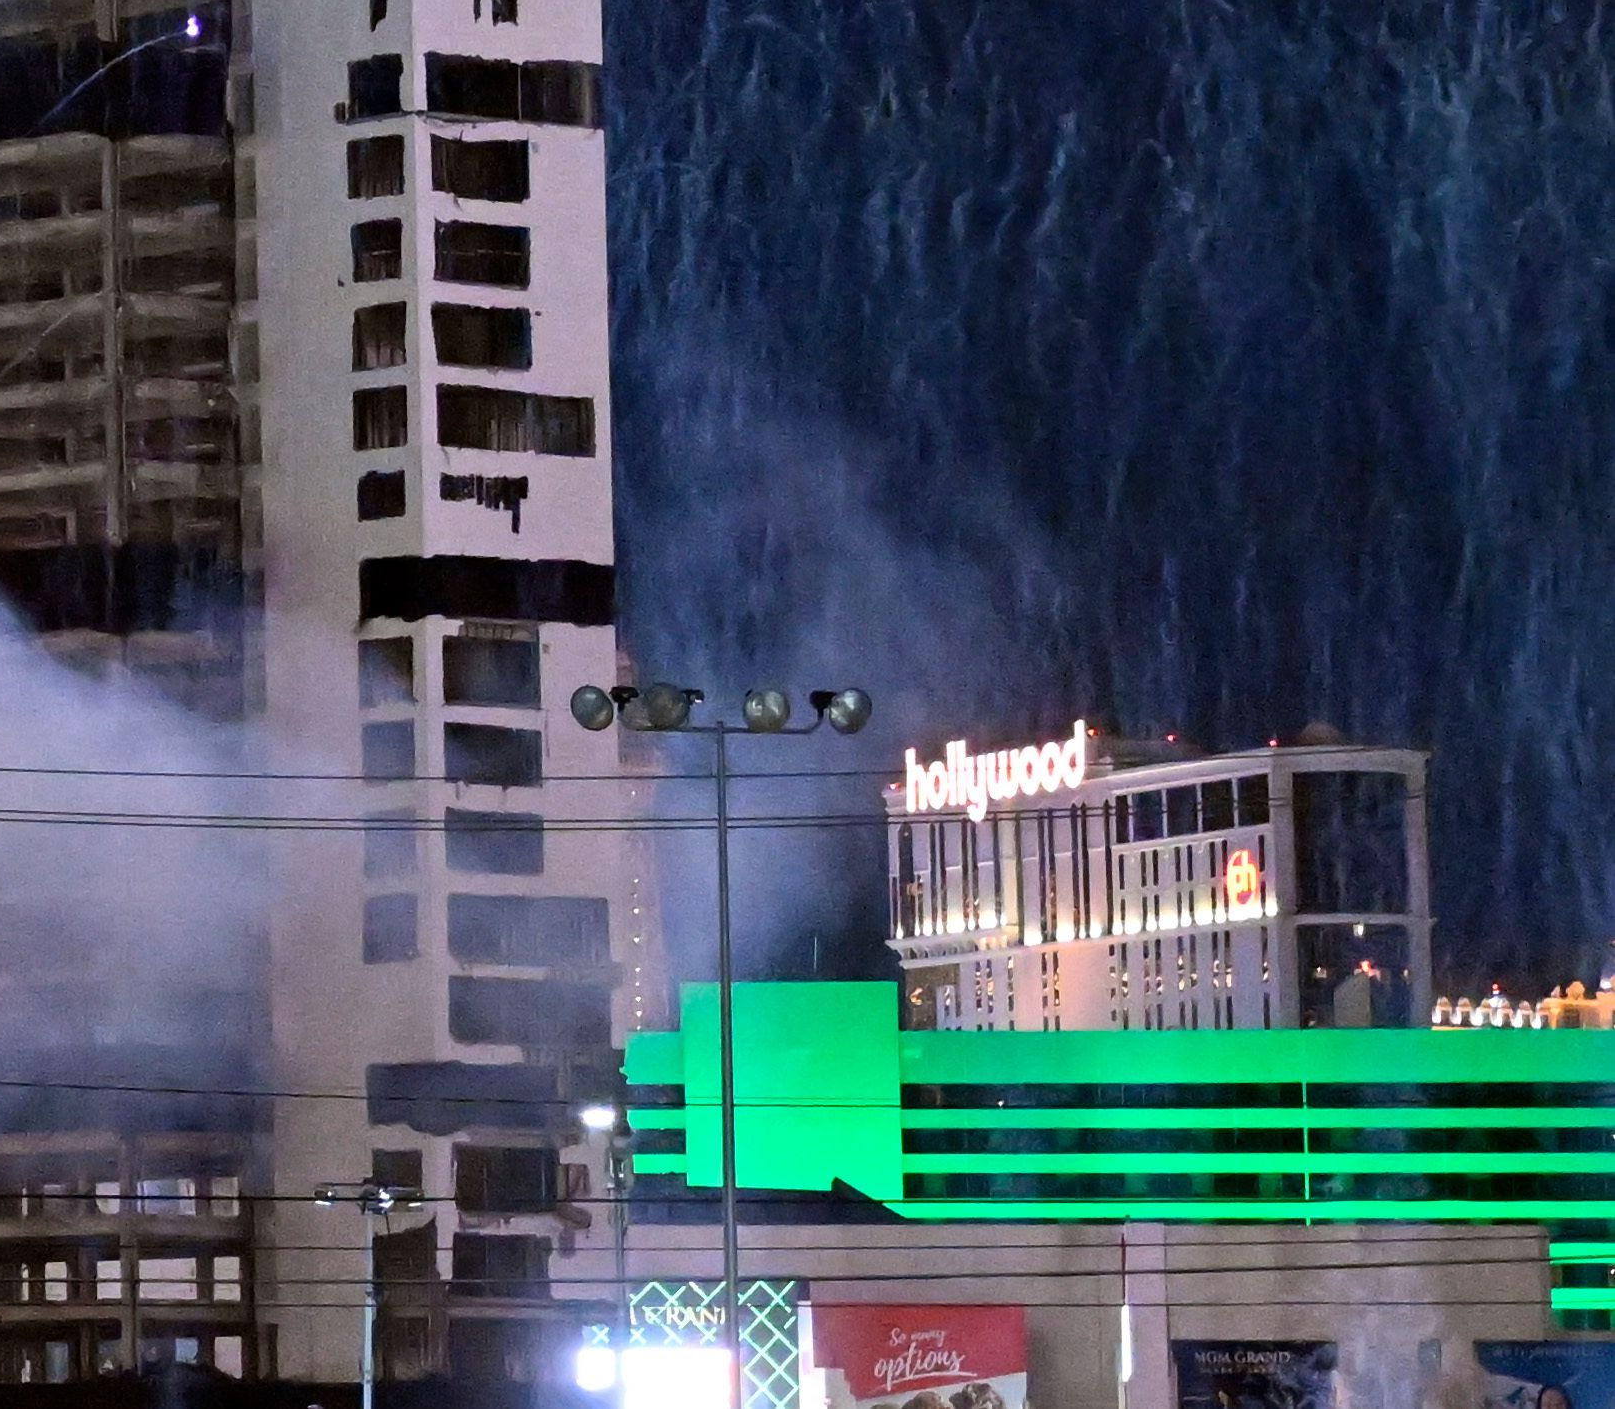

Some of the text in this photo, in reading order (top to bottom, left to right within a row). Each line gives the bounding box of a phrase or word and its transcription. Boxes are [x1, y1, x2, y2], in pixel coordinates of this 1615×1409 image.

[904, 718, 1086, 823] hollywood
[873, 1342, 967, 1392] options
[1234, 1350, 1291, 1364] GRAND
